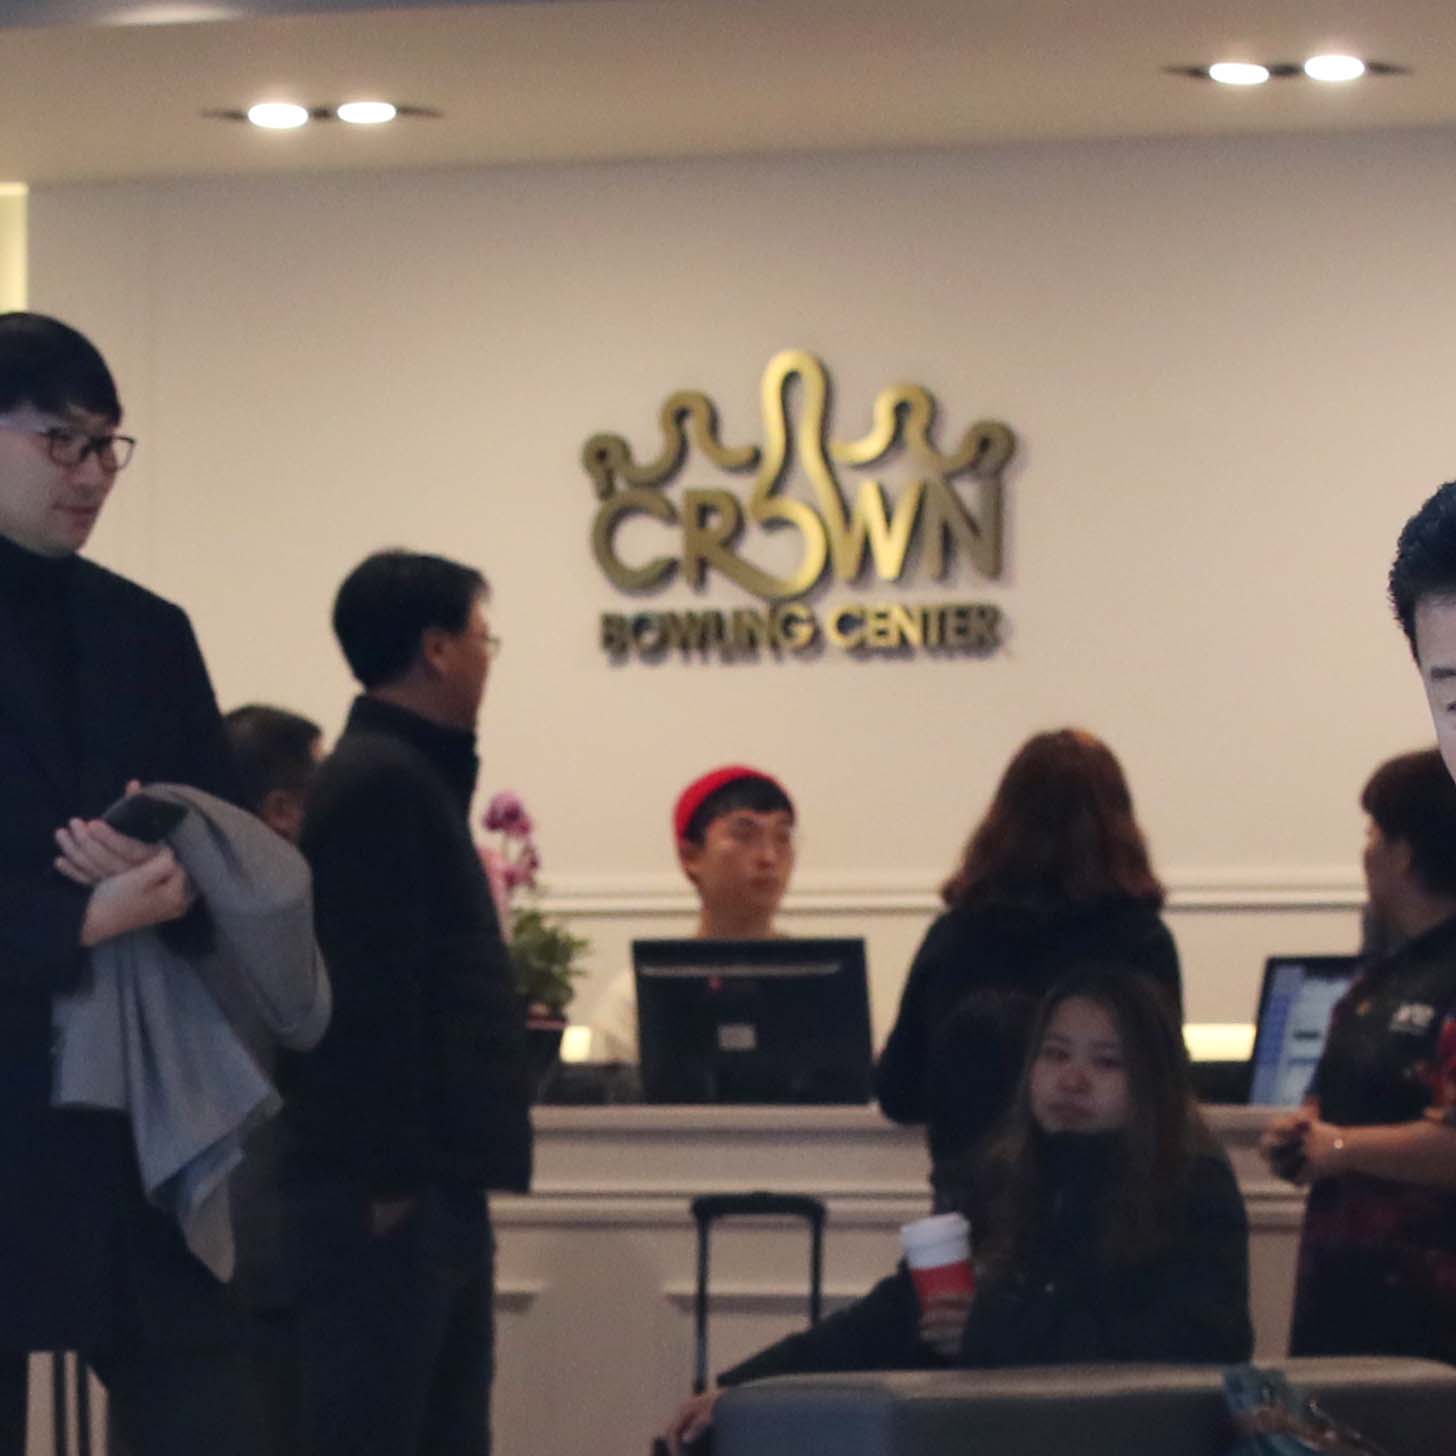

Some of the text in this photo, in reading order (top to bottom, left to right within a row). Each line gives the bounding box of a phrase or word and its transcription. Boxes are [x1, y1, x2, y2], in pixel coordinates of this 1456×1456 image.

[592, 480, 1004, 599] CROWN
[601, 602, 1002, 657] BOWLING CENTER
